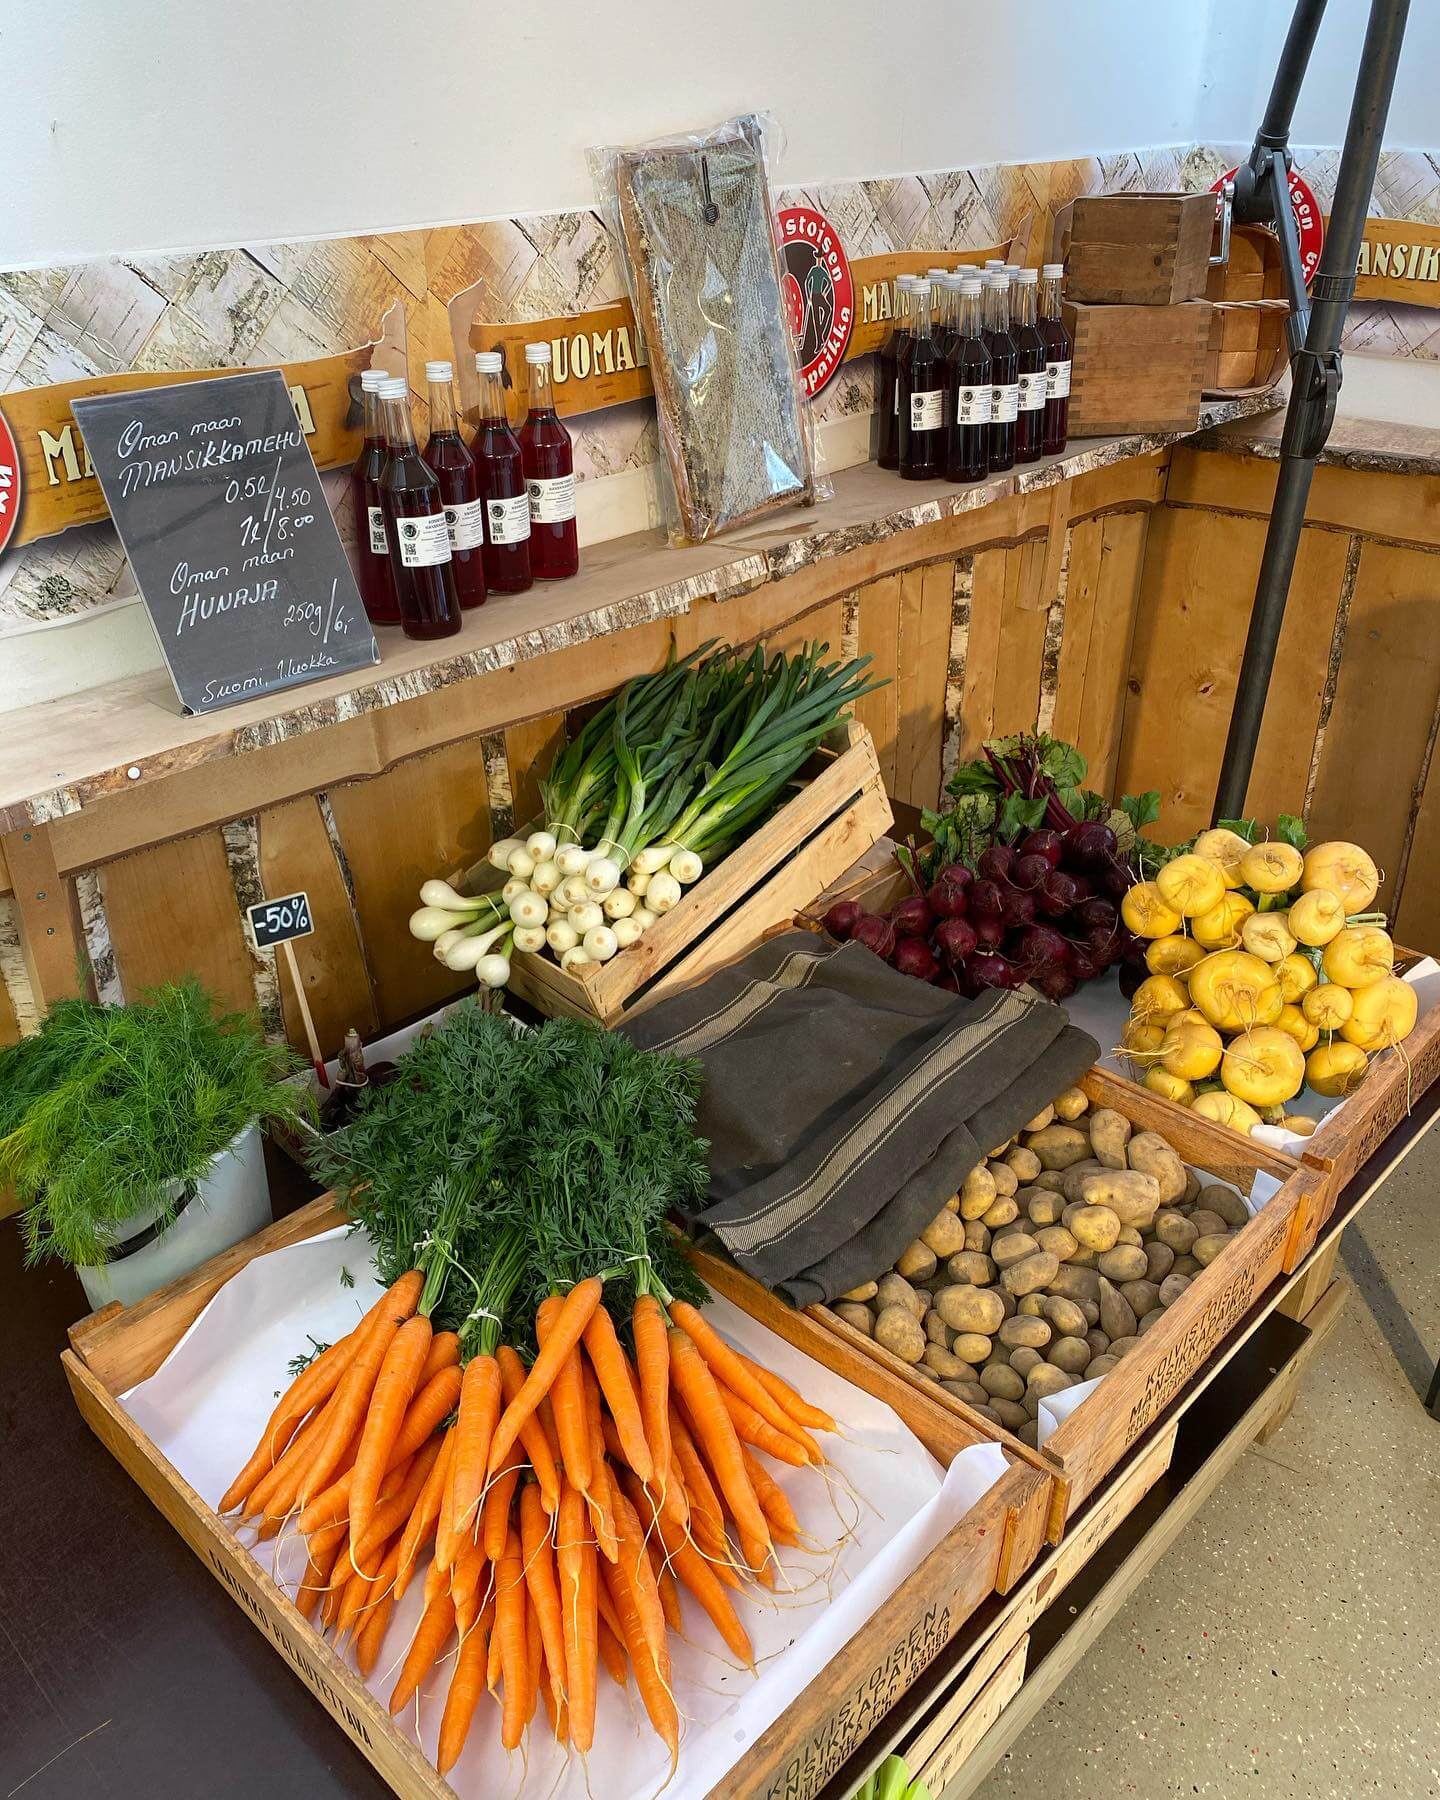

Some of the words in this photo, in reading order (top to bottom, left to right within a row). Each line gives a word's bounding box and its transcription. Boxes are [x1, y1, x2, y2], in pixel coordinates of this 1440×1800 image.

[780, 216, 843, 282] stoisen
[1355, 242, 1440, 281] ANSIK
[118, 420, 178, 459] Oman
[190, 416, 242, 436] maan
[119, 429, 302, 498] MANSIKKAMEHU
[170, 562, 229, 594] Oman
[242, 548, 294, 572] maan
[176, 579, 278, 636] HUNAJA
[254, 898, 308, 933] -50%
[272, 1622, 374, 1750] PALAUTETTAVA
[766, 1602, 938, 1800] KOIVISTOISEN
[785, 1605, 952, 1800] NSIKKAPAIKKA
